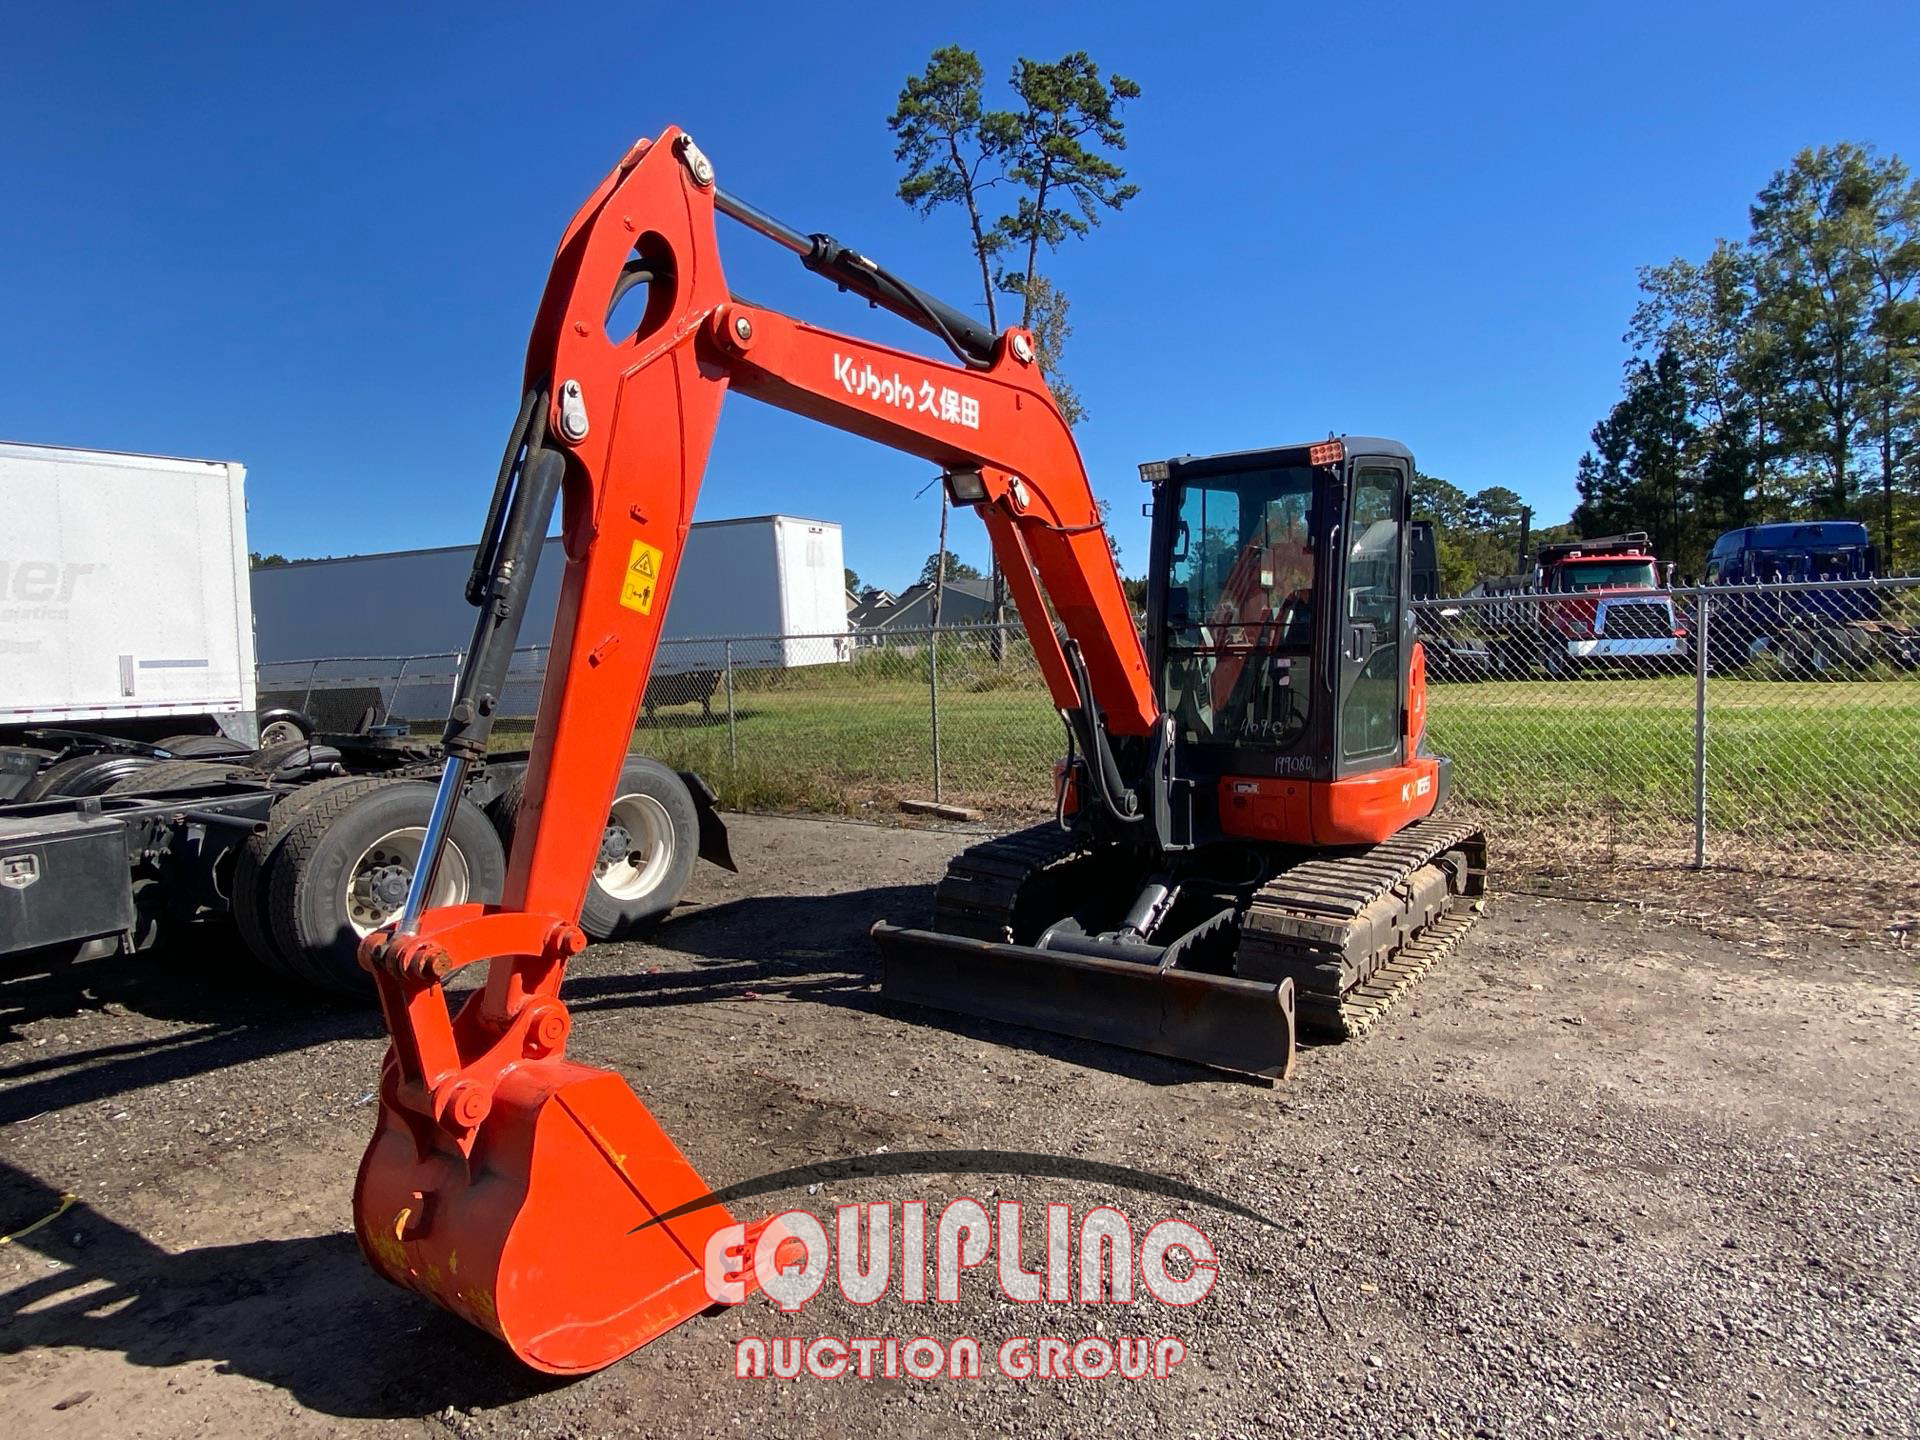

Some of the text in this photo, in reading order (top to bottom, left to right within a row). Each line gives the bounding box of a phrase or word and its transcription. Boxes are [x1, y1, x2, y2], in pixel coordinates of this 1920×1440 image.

[833, 352, 979, 430] Kubota 久保田
[0, 561, 95, 601] er
